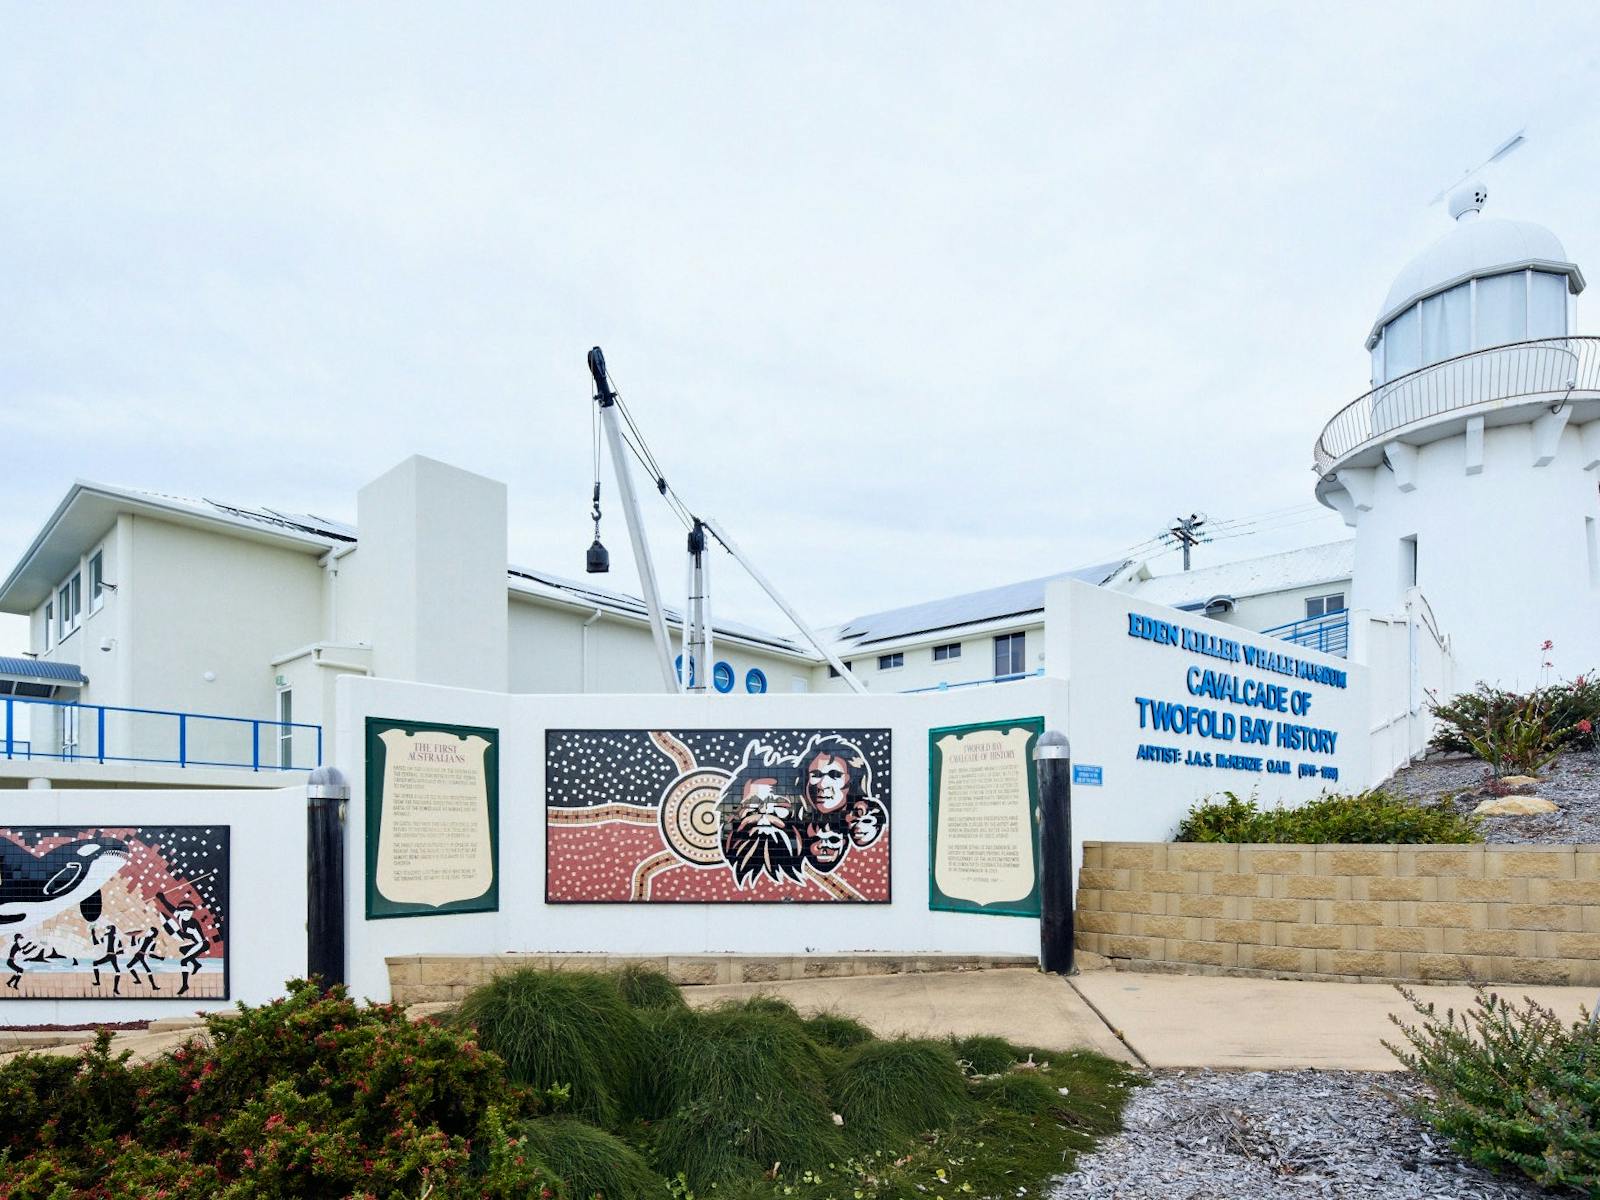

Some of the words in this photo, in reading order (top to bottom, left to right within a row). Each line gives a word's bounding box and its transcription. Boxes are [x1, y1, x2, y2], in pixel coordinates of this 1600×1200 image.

[1128, 612, 1179, 647] EDEN
[1182, 627, 1241, 662] KILLER
[1242, 644, 1294, 676] WHALE
[1294, 659, 1347, 689] MUSEUM
[1187, 665, 1288, 713] CAVALCADE
[1291, 690, 1312, 716] OF
[1135, 697, 1236, 740] TWOFOLD
[1240, 715, 1273, 746] BAY
[1276, 721, 1338, 755] HISTORY
[408, 751, 465, 763] AUSTRALIANS
[414, 742, 432, 753] THE
[434, 743, 457, 754] FIRST
[1136, 744, 1182, 764] ARTIST:
[1185, 750, 1213, 768] J.A.S.
